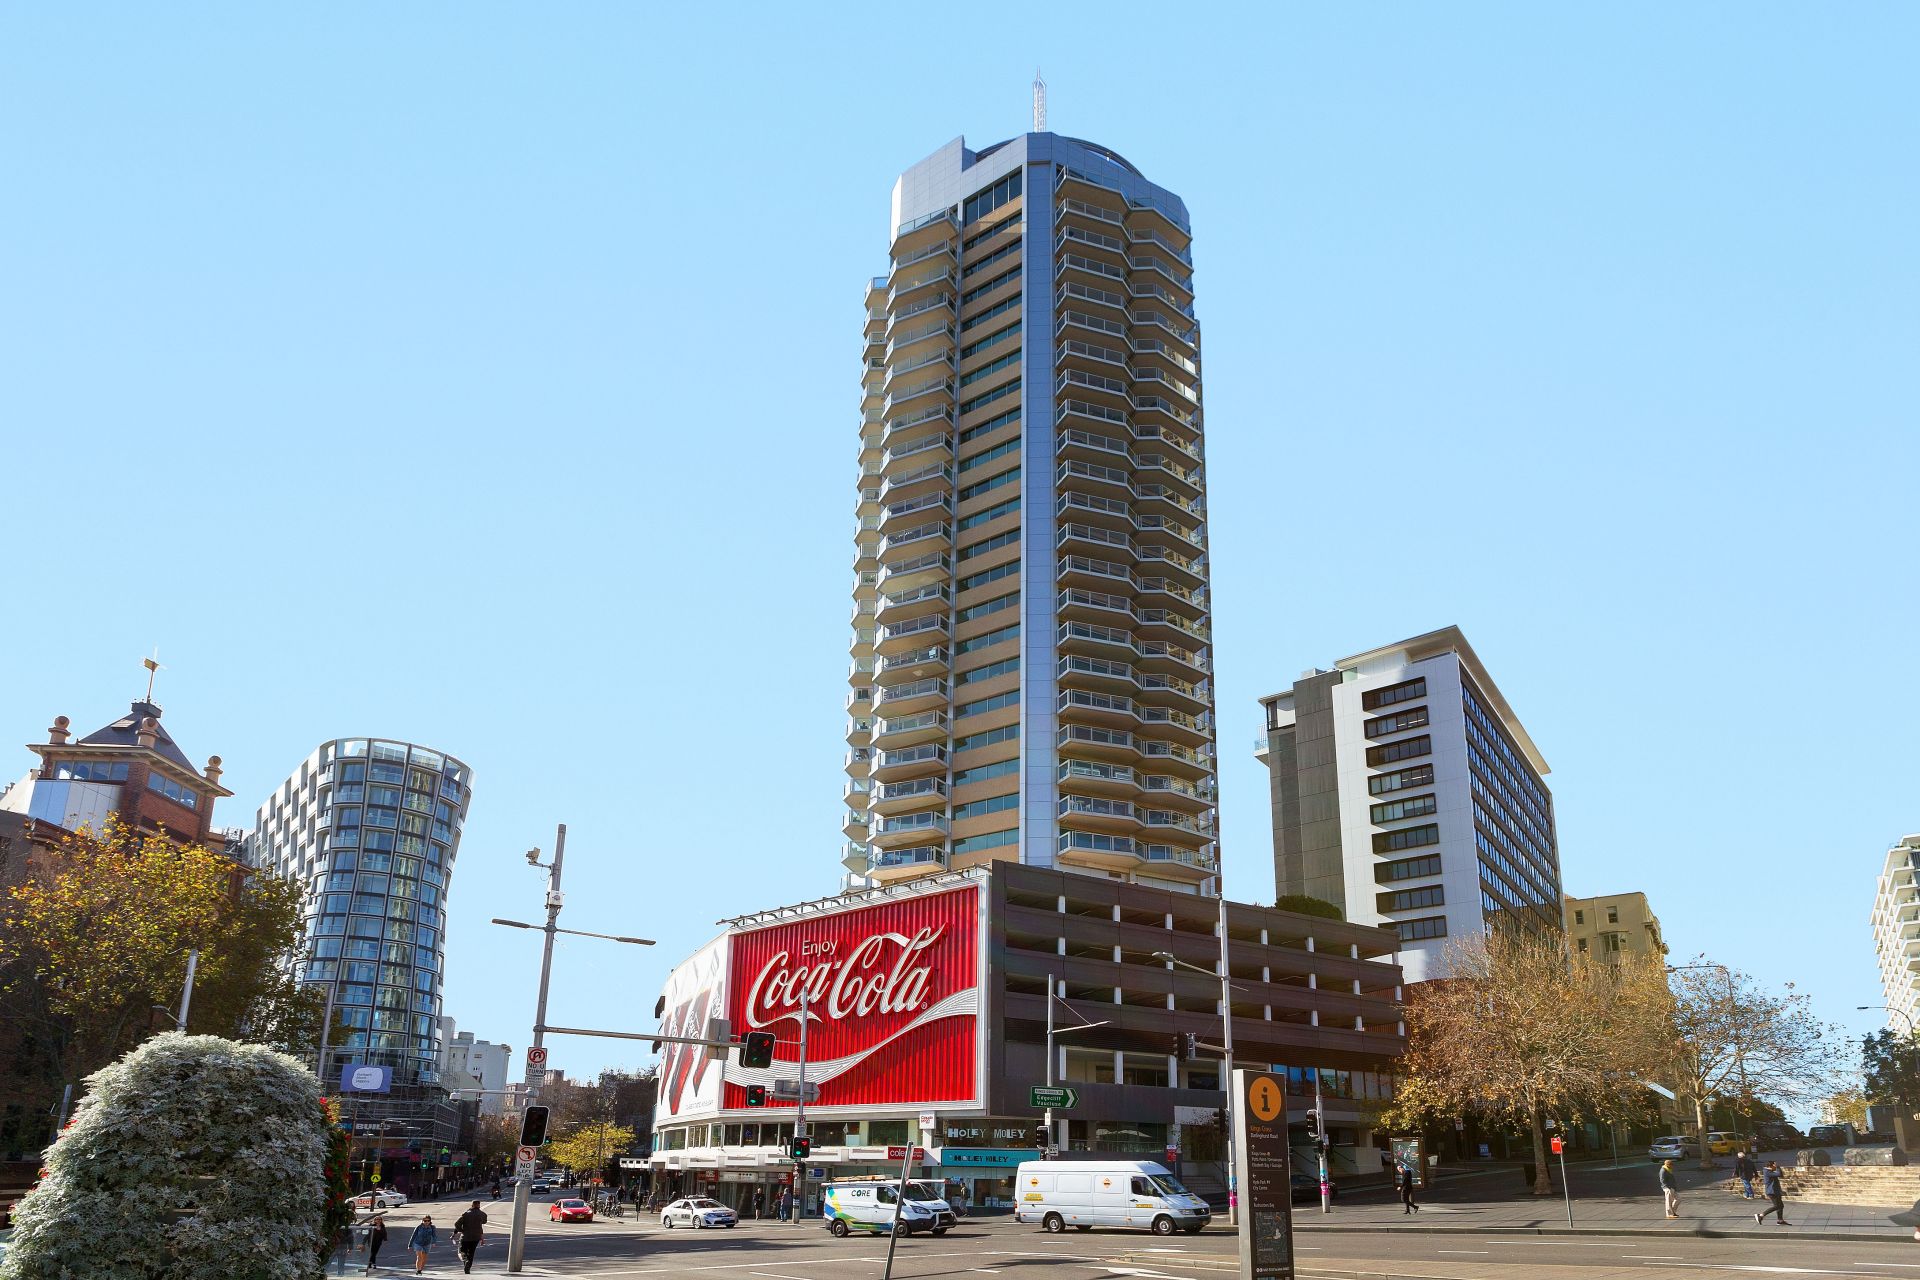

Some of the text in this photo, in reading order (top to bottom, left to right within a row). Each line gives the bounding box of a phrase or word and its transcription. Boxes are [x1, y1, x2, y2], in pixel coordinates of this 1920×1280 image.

[802, 939, 838, 957] Enjoy
[746, 922, 949, 1028] Coca-Cola
[947, 1128, 1026, 1139] HOLEY MOLEY
[890, 1148, 905, 1157] cole
[851, 1189, 871, 1197] CORE
